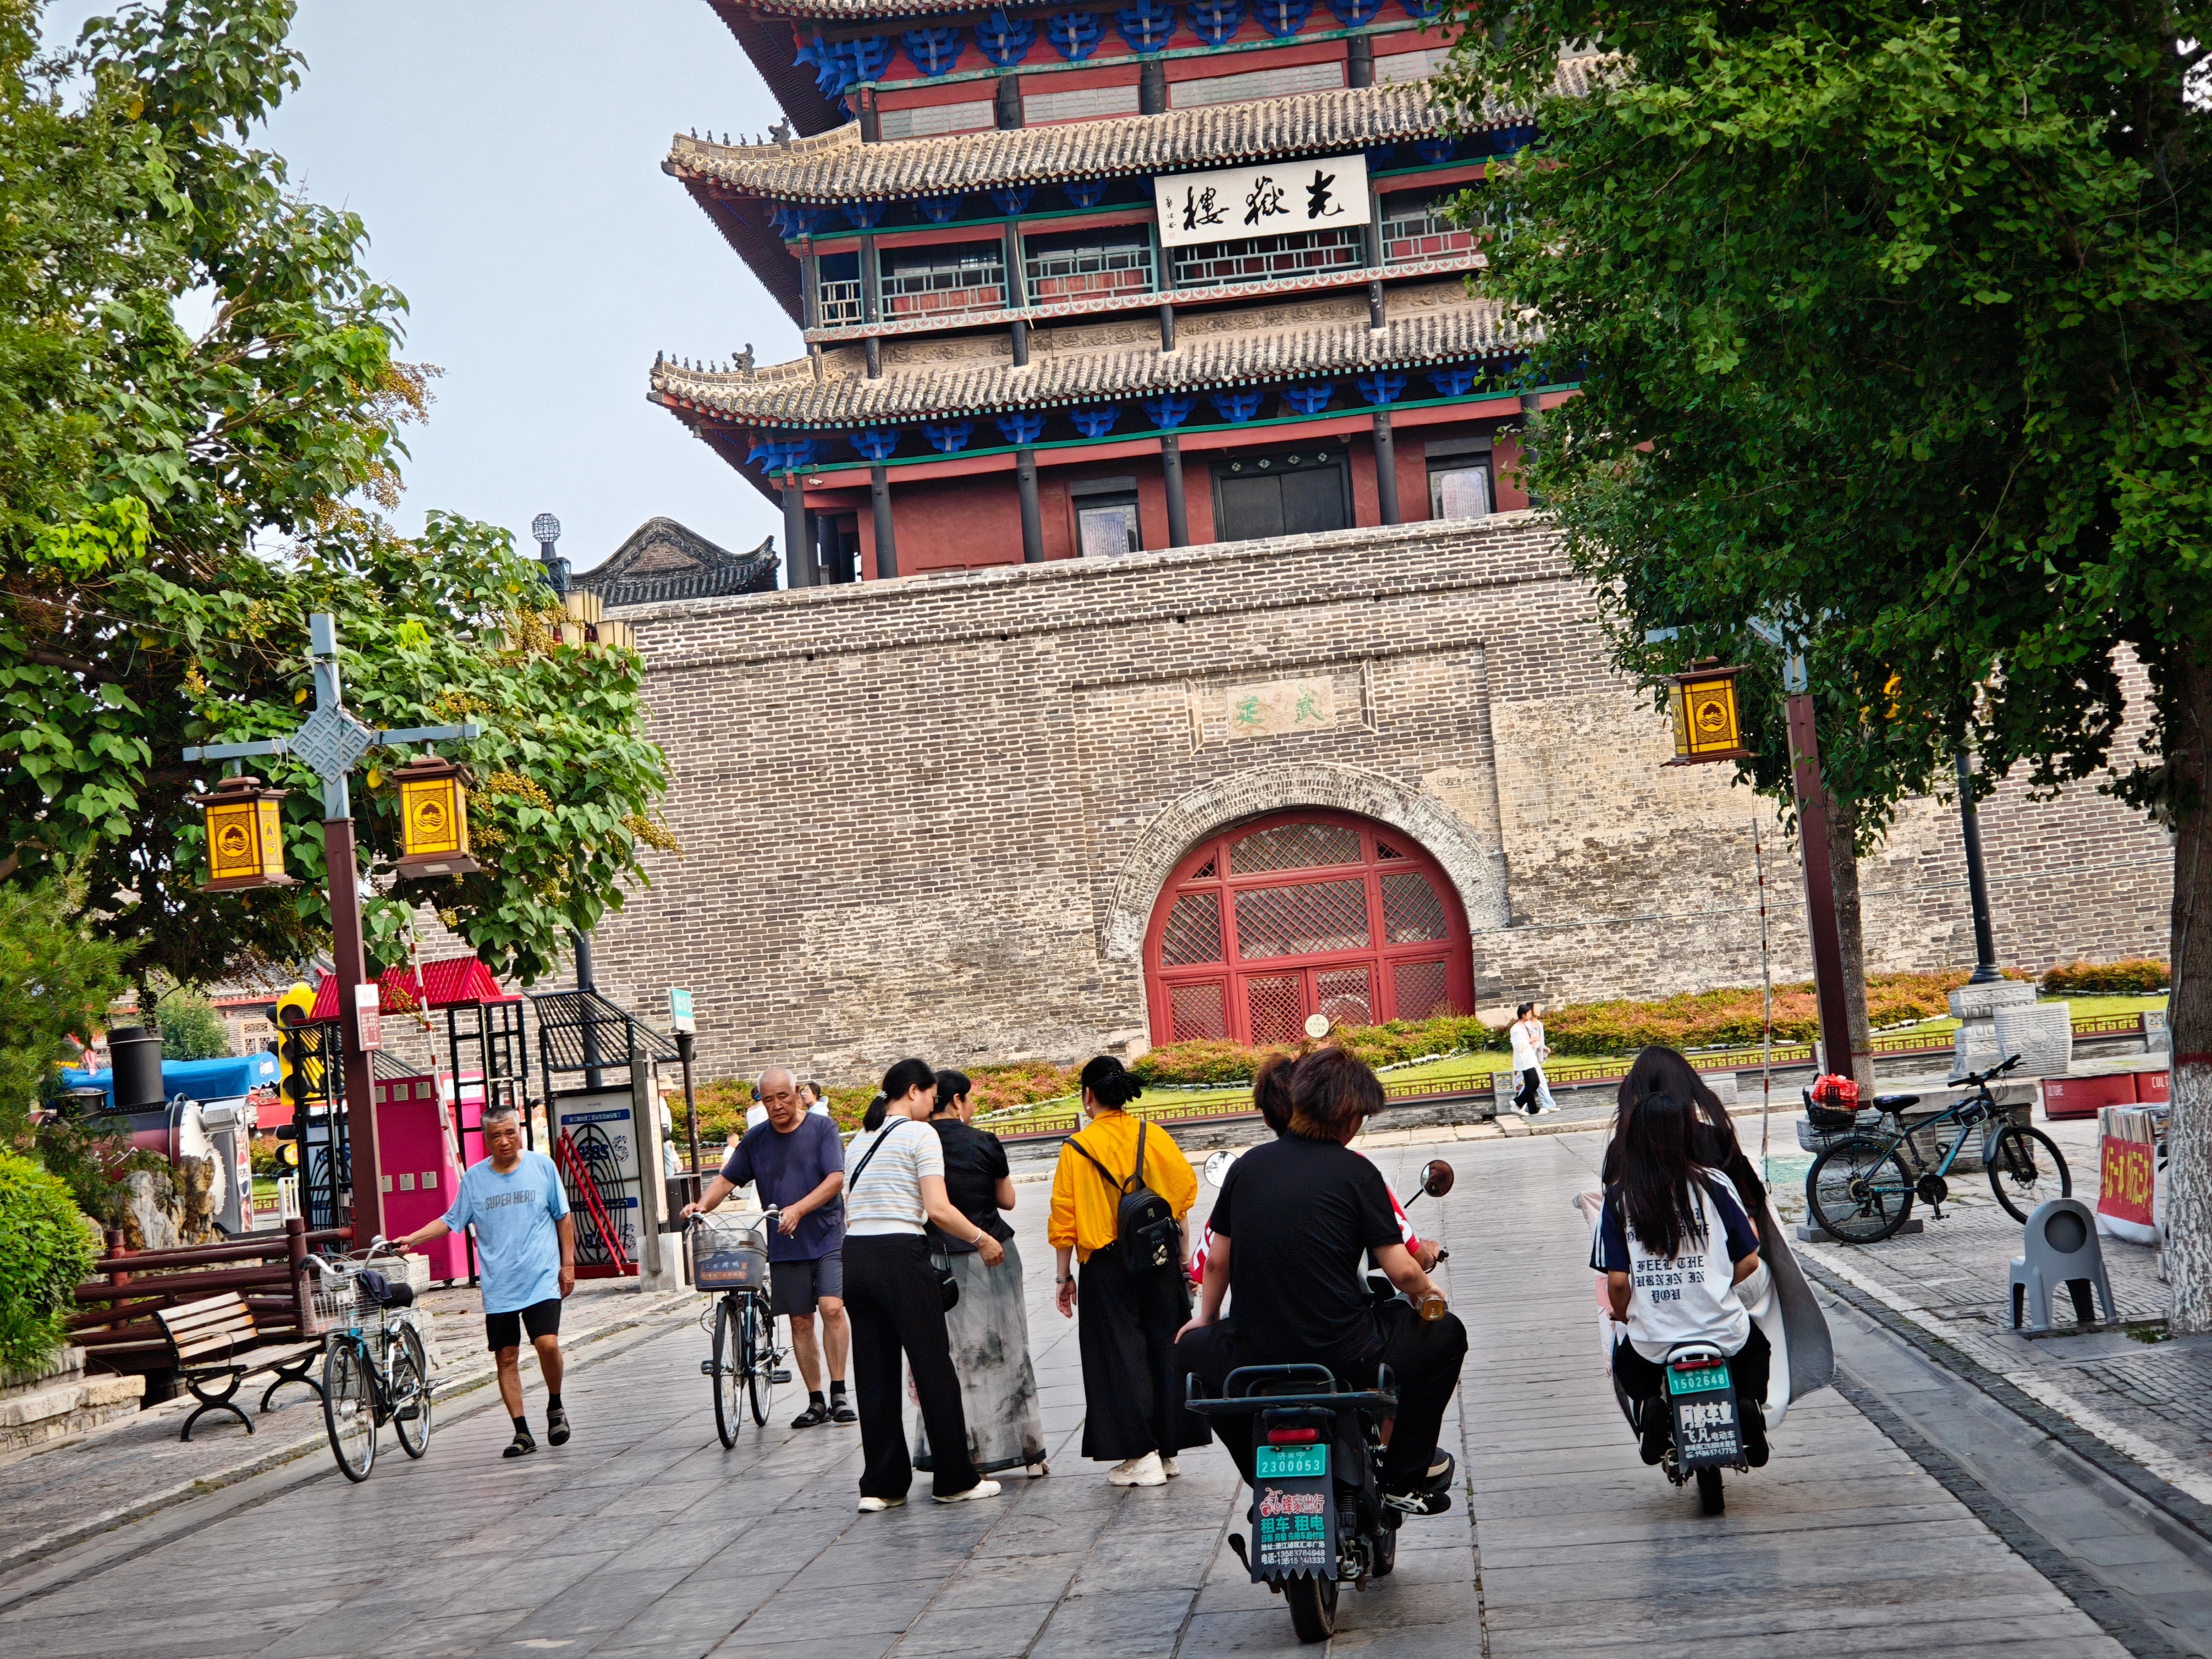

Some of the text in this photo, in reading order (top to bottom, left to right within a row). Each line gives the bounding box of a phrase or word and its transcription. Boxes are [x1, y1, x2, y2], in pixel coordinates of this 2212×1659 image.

[485, 1190, 536, 1210] SUPER HERO
[1636, 1256, 1704, 1272] FEEL THE
[1651, 1289, 1681, 1303] YOU
[1674, 1374, 1724, 1390] 1502648
[1262, 1460, 1319, 1473] 2300053
[1261, 1514, 1325, 1534] 租车 租电
